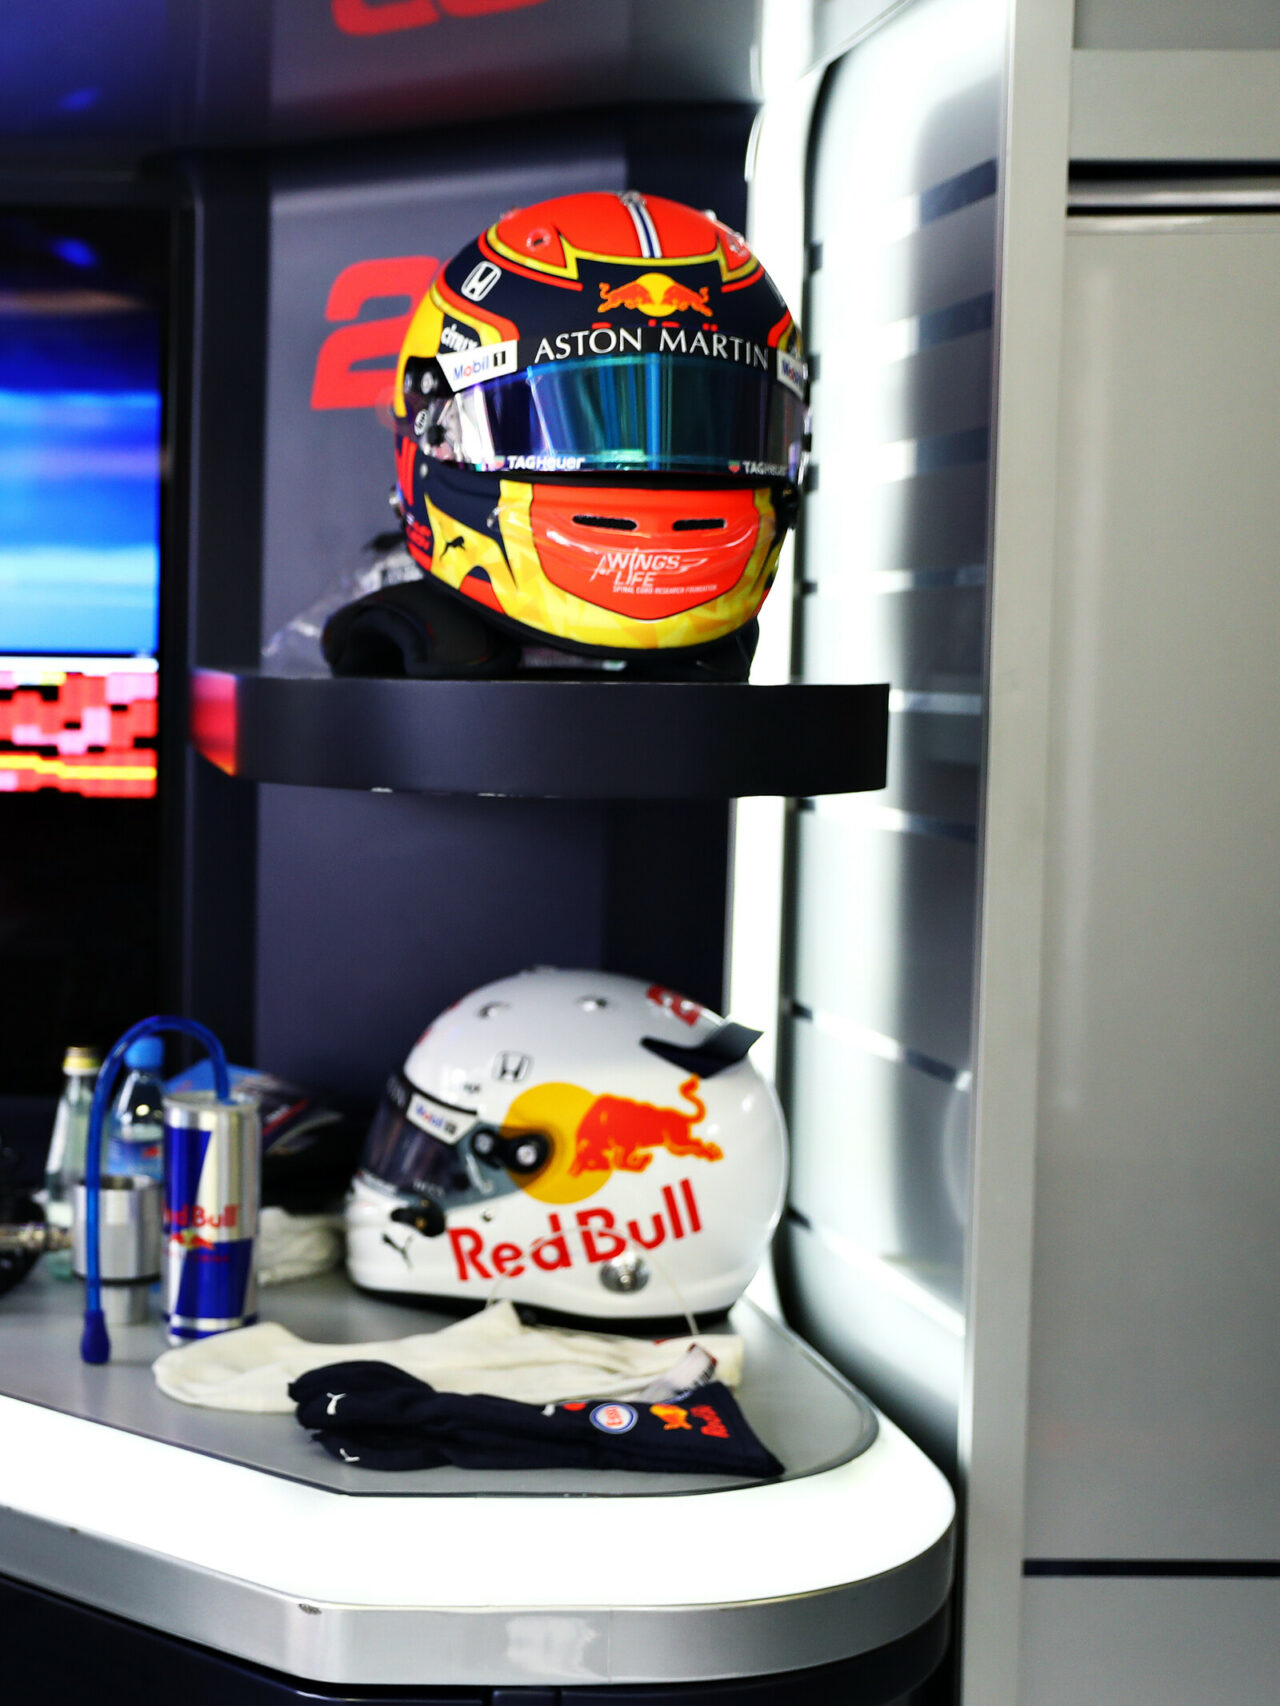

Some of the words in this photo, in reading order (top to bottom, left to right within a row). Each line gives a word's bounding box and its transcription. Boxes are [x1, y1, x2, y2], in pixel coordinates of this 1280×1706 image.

[534, 327, 642, 364] ASTON
[659, 328, 769, 371] MARTIN
[454, 355, 489, 380] Mobil
[494, 350, 506, 367] 1
[606, 548, 681, 571] WINGS
[613, 570, 657, 587] LIFE
[447, 1212, 573, 1281] Red
[576, 1178, 702, 1263] Bull
